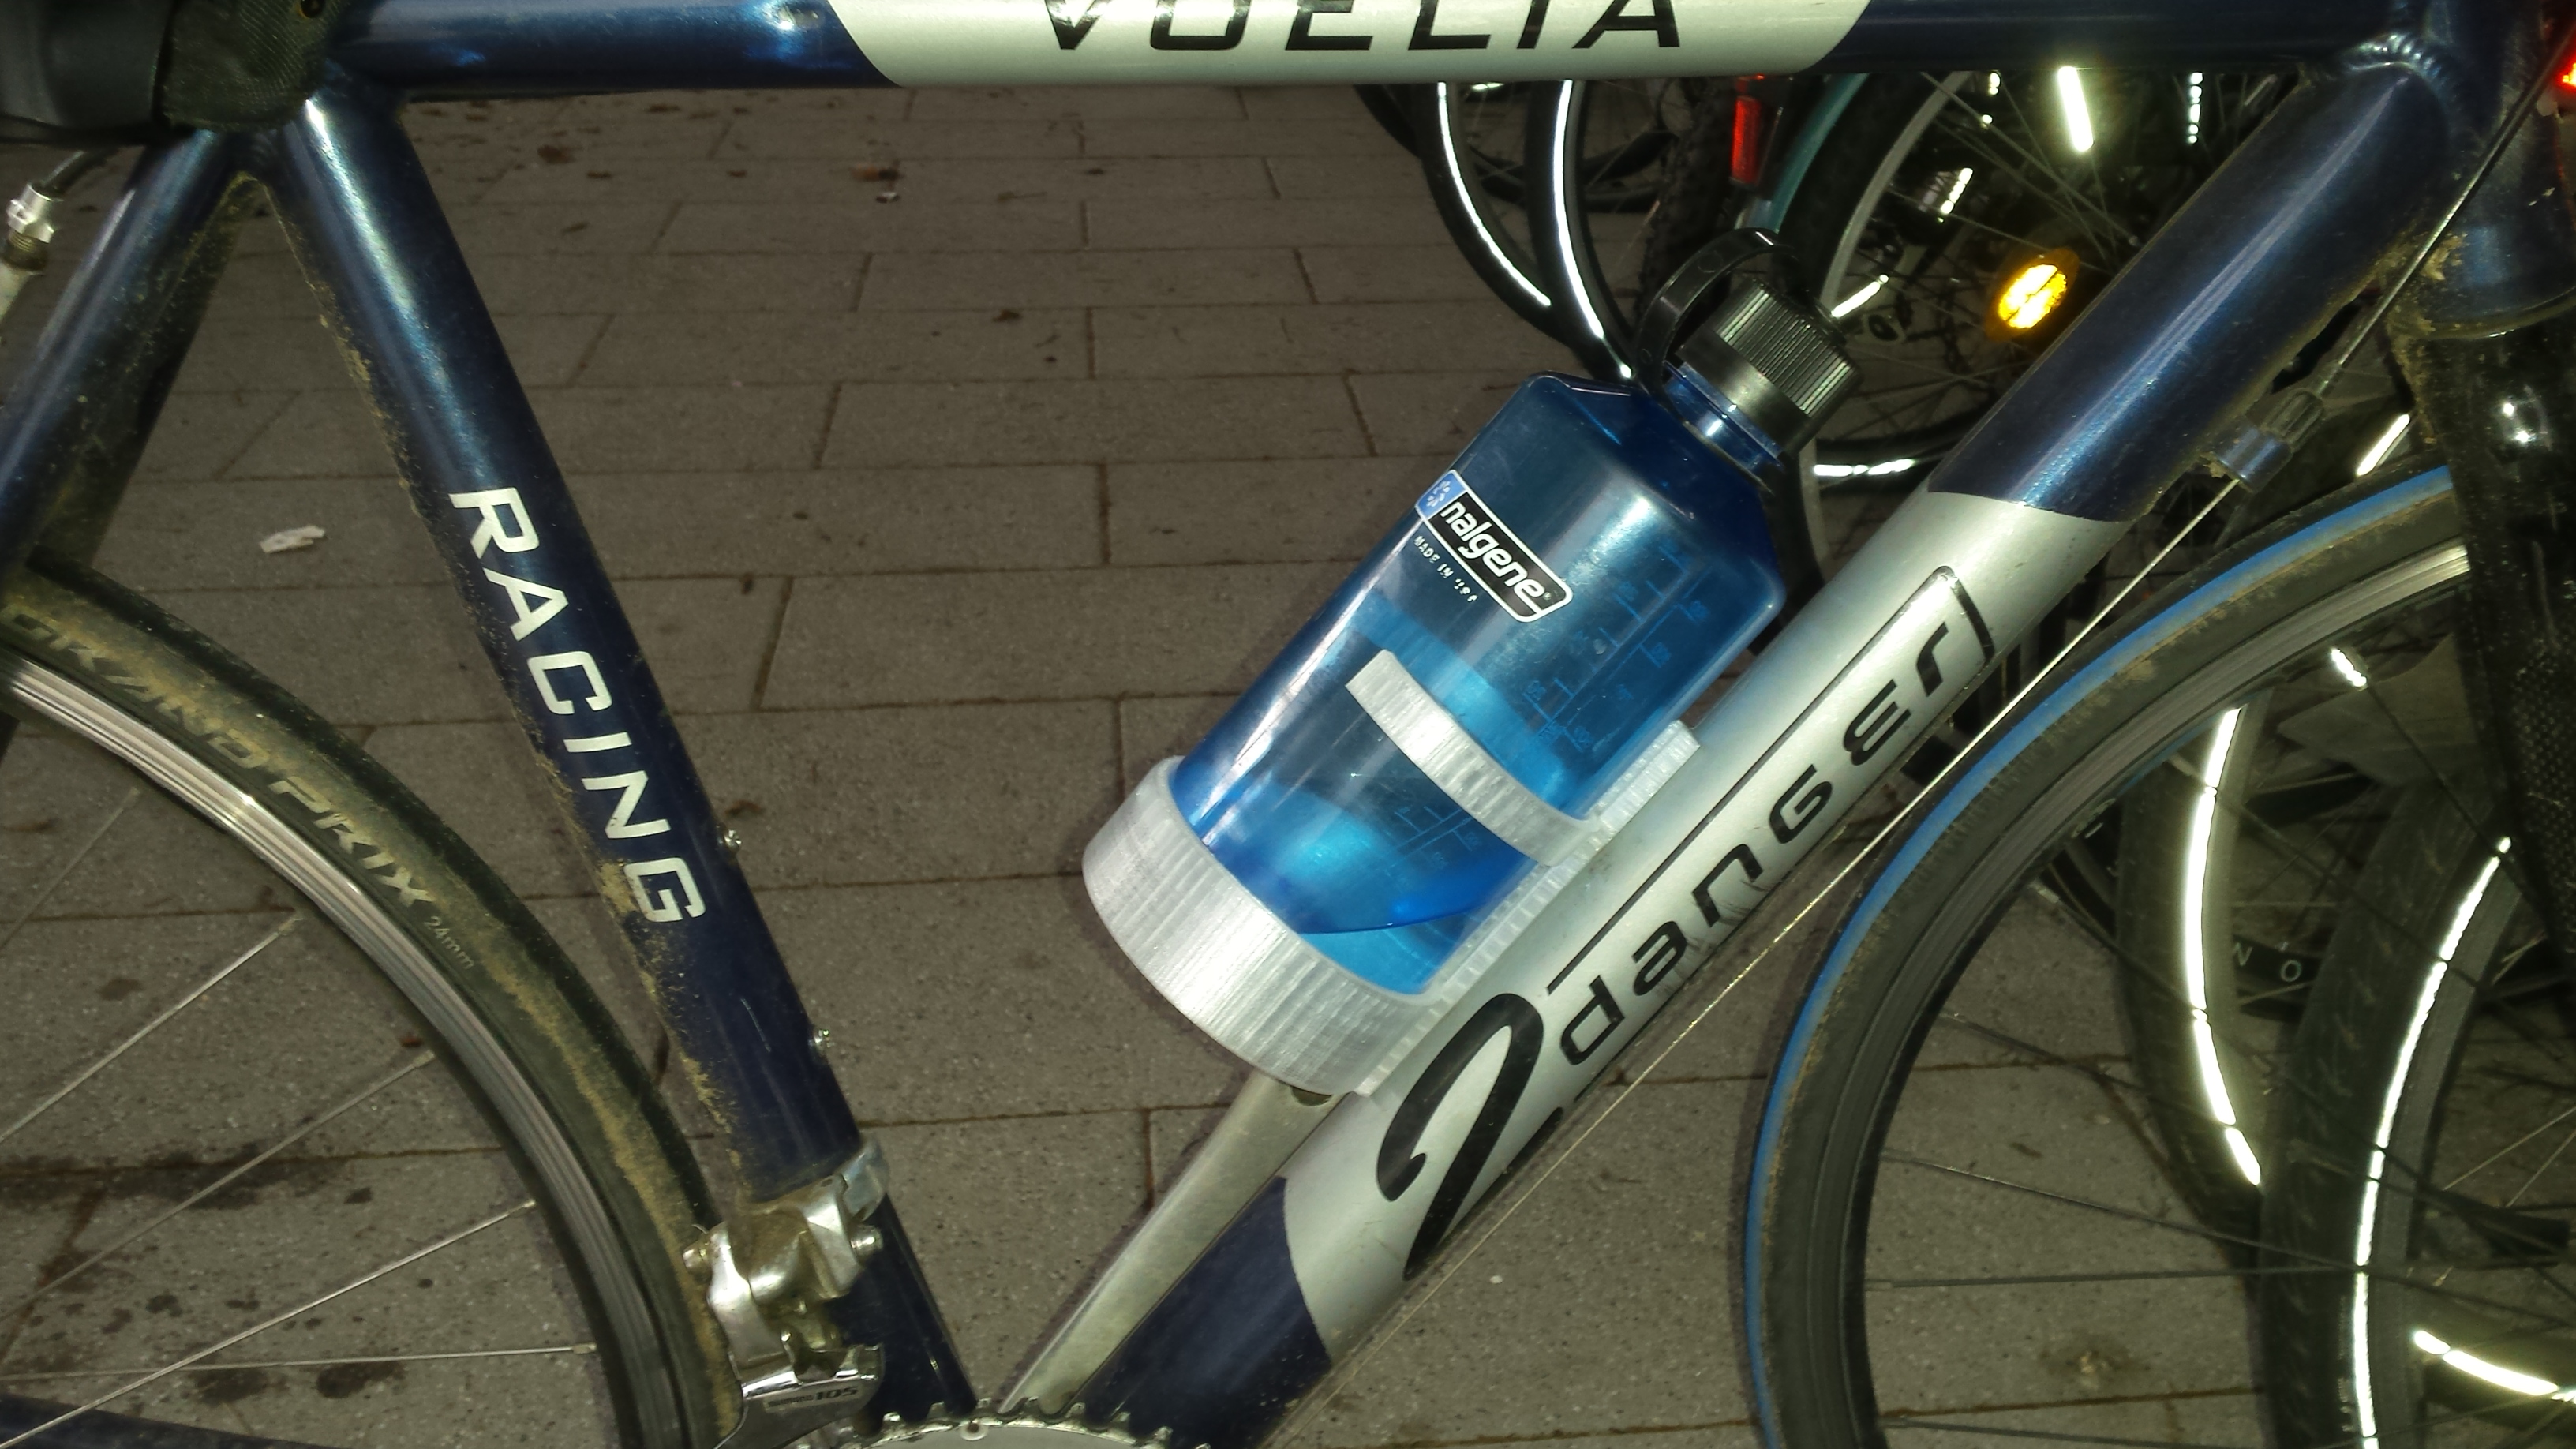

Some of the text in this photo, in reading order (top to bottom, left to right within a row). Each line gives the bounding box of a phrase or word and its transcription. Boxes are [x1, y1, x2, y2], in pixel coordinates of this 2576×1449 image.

[1413, 535, 1440, 564] MADE
[1436, 563, 1454, 580] IN
[1440, 501, 1545, 601] nalgene
[449, 487, 706, 923] RACING
[270, 775, 435, 907] PRIX
